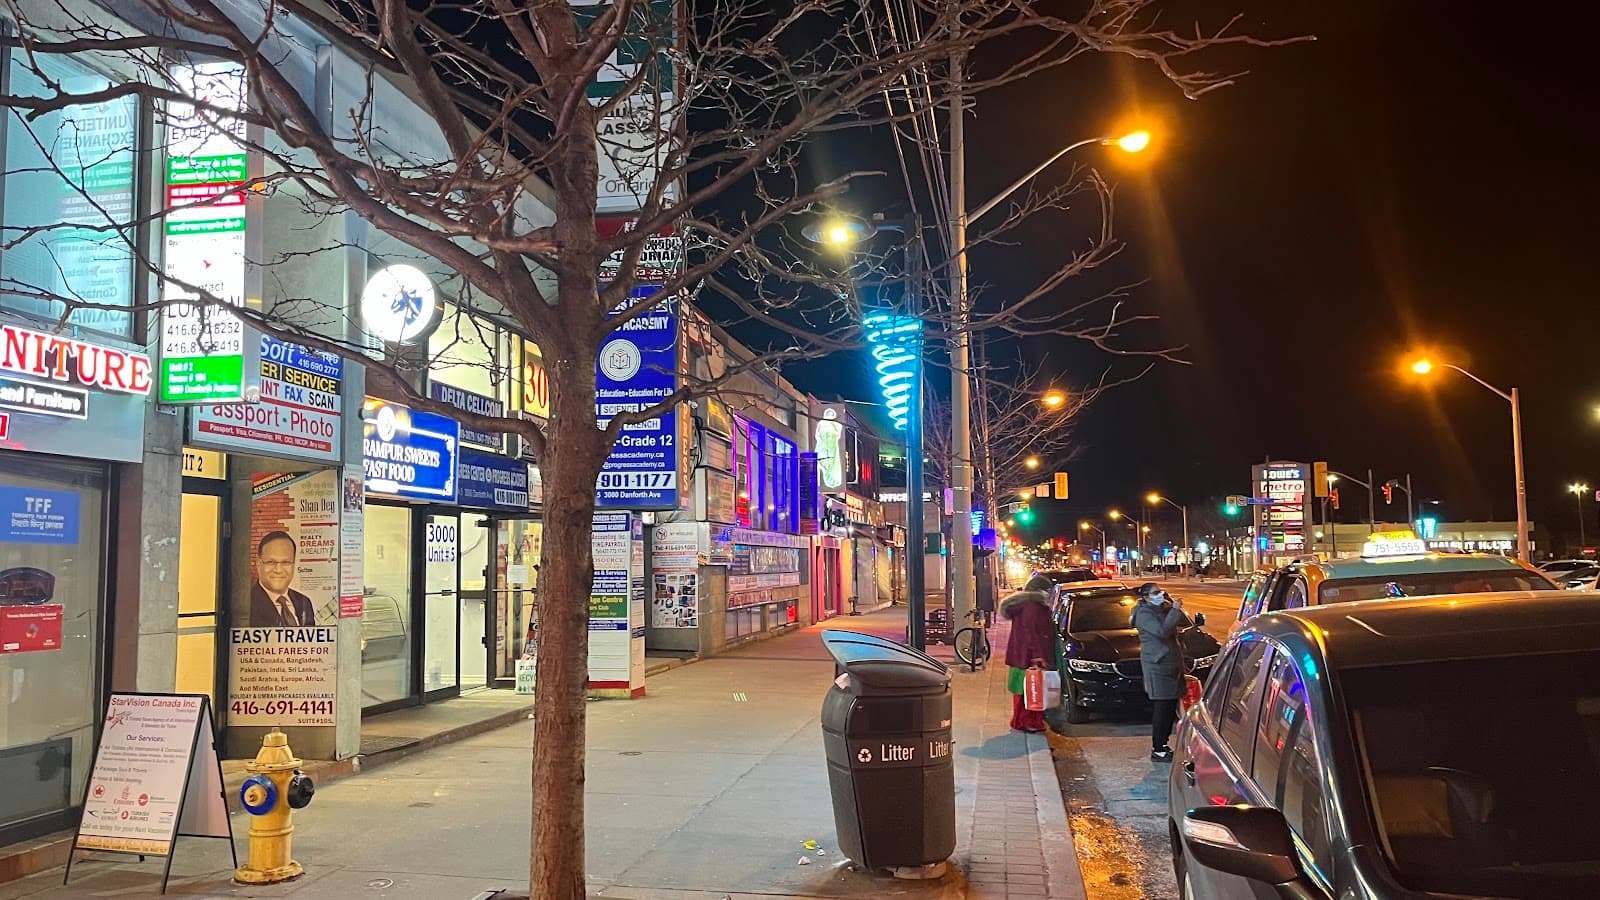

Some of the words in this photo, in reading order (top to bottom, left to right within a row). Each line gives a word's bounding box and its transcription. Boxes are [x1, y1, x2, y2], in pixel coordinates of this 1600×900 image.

[298, 357, 310, 368] 416
[310, 359, 323, 372] 690
[324, 364, 339, 376] 2777
[285, 368, 336, 394] SERVICE
[26, 386, 81, 411] Furniture
[284, 385, 303, 403] FAX
[308, 391, 334, 410] SCAN
[600, 389, 626, 398] Education
[629, 388, 654, 397] Education
[654, 387, 663, 397] For
[603, 405, 637, 414] SCIENCE
[290, 410, 334, 438] Photo
[661, 435, 673, 446] 12
[364, 438, 403, 461] RAMPUR
[405, 446, 440, 468] SWEETS
[182, 454, 194, 471] IT
[197, 456, 203, 472] 2
[388, 463, 415, 483] FOOD
[601, 473, 672, 487] 901-1177
[254, 473, 296, 493] RESIDENTIAL
[1263, 482, 1302, 491] metro
[620, 491, 648, 499] Danforth
[649, 491, 661, 499] Ave
[25, 497, 52, 513] TFF
[300, 499, 319, 513] Shan
[429, 524, 456, 543] 3000
[300, 540, 335, 548] DREAMS
[1374, 542, 1420, 553] 751-5555
[1479, 541, 1512, 550] HOUSE
[231, 629, 272, 643] EASY
[275, 628, 335, 643] TRAVEL
[237, 647, 276, 655] SPECIAL
[278, 647, 308, 655] FARES
[310, 647, 329, 655] FOR
[111, 697, 150, 707] StarVision
[152, 698, 182, 708] Canada
[183, 698, 197, 708] Inc.
[231, 700, 334, 715] 416-691-4141
[881, 743, 915, 762] Litter
[929, 741, 950, 758] Litter
